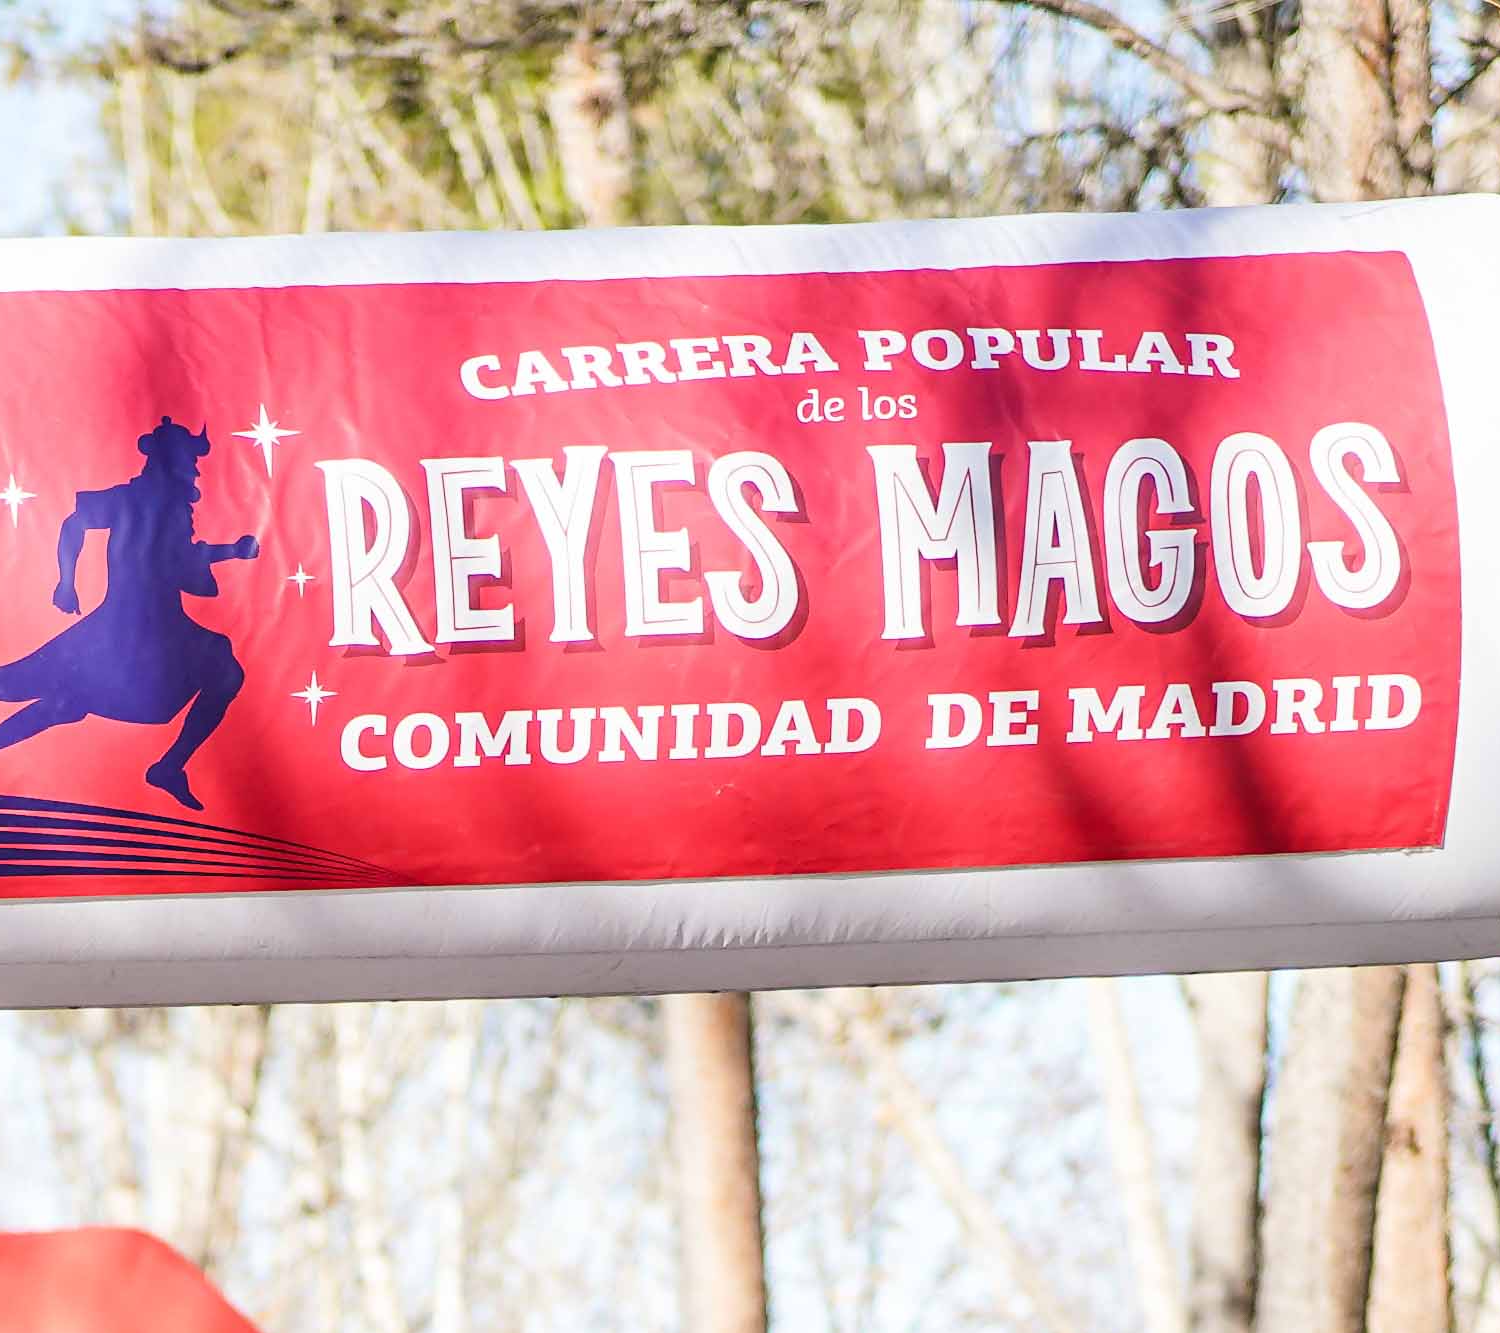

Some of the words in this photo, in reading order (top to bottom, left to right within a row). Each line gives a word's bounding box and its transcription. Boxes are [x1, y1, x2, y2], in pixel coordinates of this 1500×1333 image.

[458, 330, 828, 401] CARRERA
[857, 327, 1241, 380] POPULAR
[796, 389, 846, 425] de
[856, 385, 919, 422] los
[315, 444, 805, 659] REYES
[866, 422, 1406, 644] MAGOS
[339, 695, 883, 774] COMUNIDAD
[924, 688, 1042, 752] DE
[1064, 671, 1424, 745] MADRID
